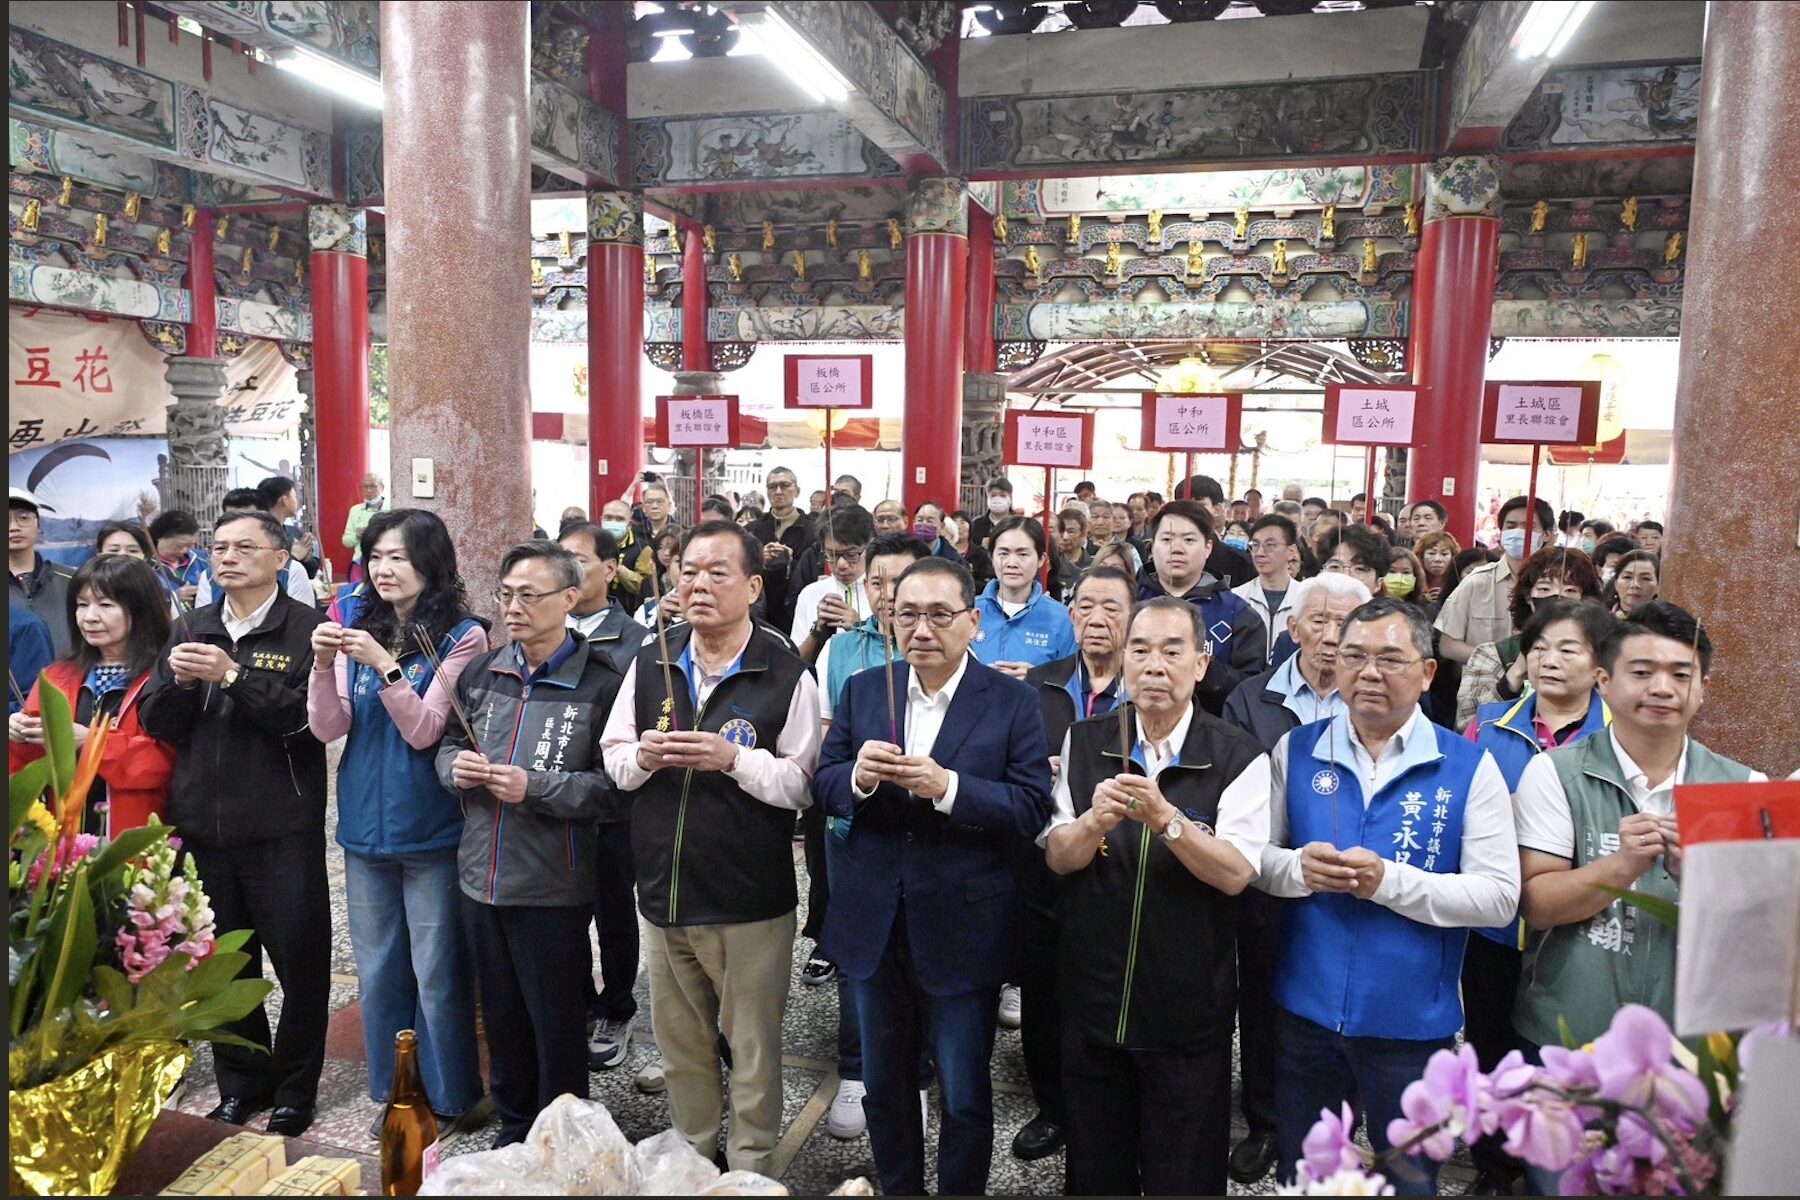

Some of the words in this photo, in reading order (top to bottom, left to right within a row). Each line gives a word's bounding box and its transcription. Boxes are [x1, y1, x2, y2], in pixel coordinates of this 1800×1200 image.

[15, 345, 113, 393] 豆花
[816, 366, 840, 378] 板橋
[810, 382, 847, 393] 區公所
[1361, 398, 1389, 411] 土城
[1514, 397, 1561, 410] 土城區
[680, 408, 714, 419] 板橋區
[1177, 405, 1203, 417] 中和
[1352, 416, 1395, 429] 區公所
[1504, 414, 1570, 426] 里長聯誼會
[674, 423, 722, 433] 里長聯誼會
[1032, 425, 1066, 438] 中和區
[1169, 422, 1209, 435] 區公所
[1024, 441, 1074, 453] 里長聯誼會
[1423, 786, 1453, 871] 新北市議員
